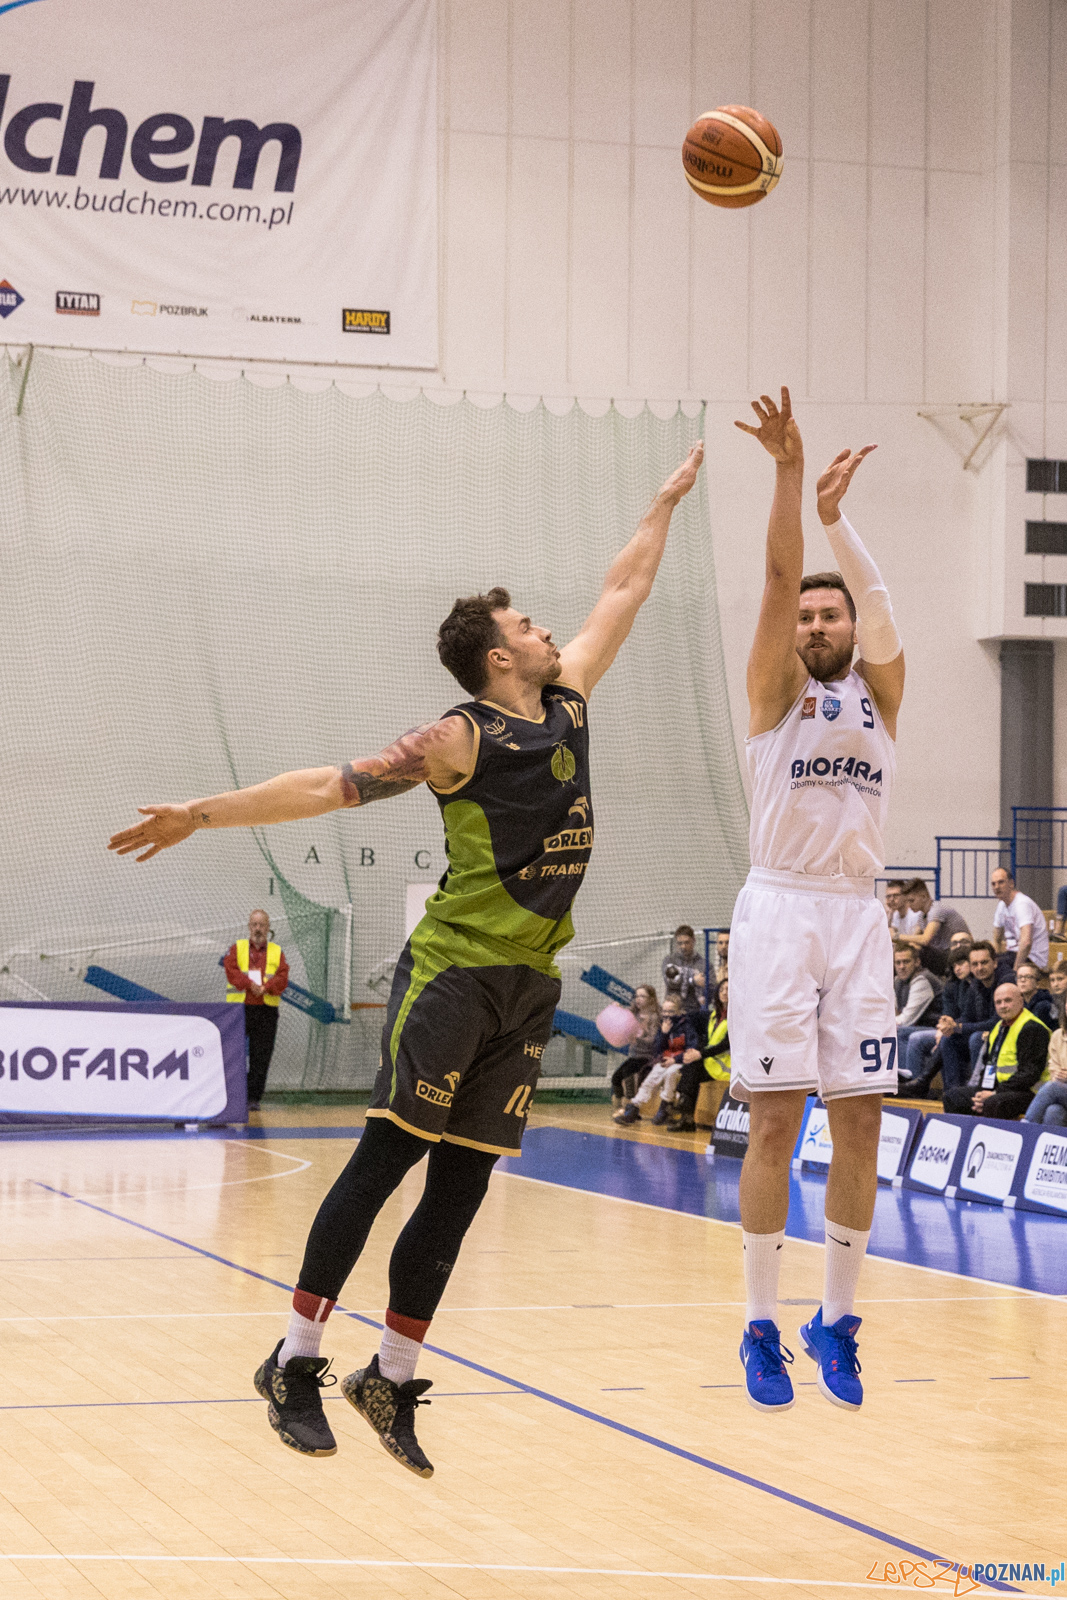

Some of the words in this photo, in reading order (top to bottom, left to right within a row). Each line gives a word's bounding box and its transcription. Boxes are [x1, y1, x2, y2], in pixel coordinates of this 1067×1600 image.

[0, 74, 302, 193] chem
[0, 186, 294, 230] www.budchem.com.pl
[58, 293, 99, 310] TYTAN
[159, 304, 208, 317] POZBRUK
[345, 311, 388, 327] HARDY
[548, 829, 592, 849] ORLEN
[304, 845, 321, 864] A
[359, 847, 380, 866] B
[414, 850, 431, 869] C
[860, 1037, 896, 1072] 97
